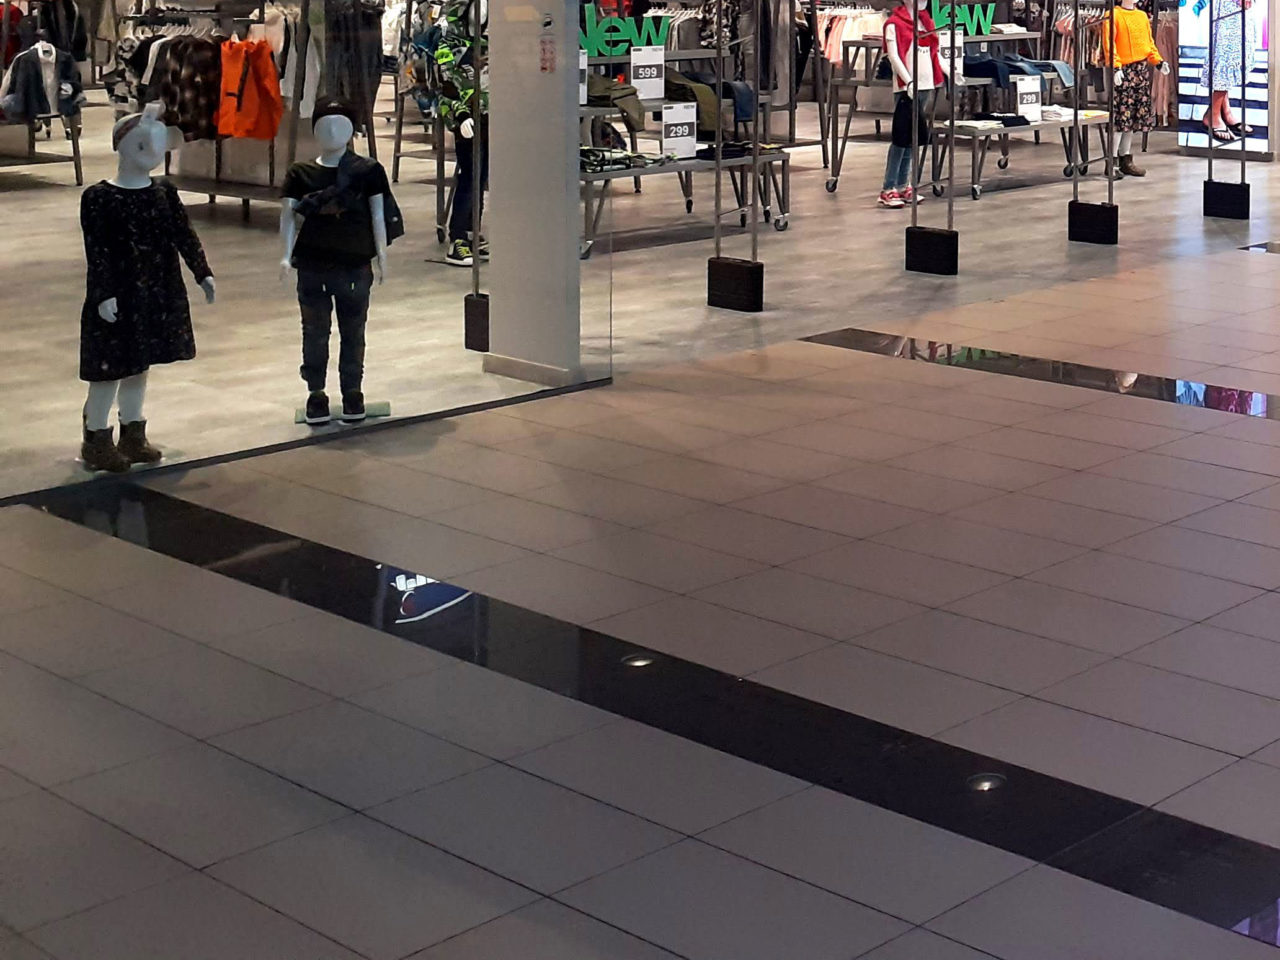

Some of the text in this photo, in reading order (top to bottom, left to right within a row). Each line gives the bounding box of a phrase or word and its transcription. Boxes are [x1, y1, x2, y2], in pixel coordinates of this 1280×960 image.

[638, 67, 658, 78] 599
[1022, 94, 1036, 104] 299
[669, 125, 689, 137] 299
